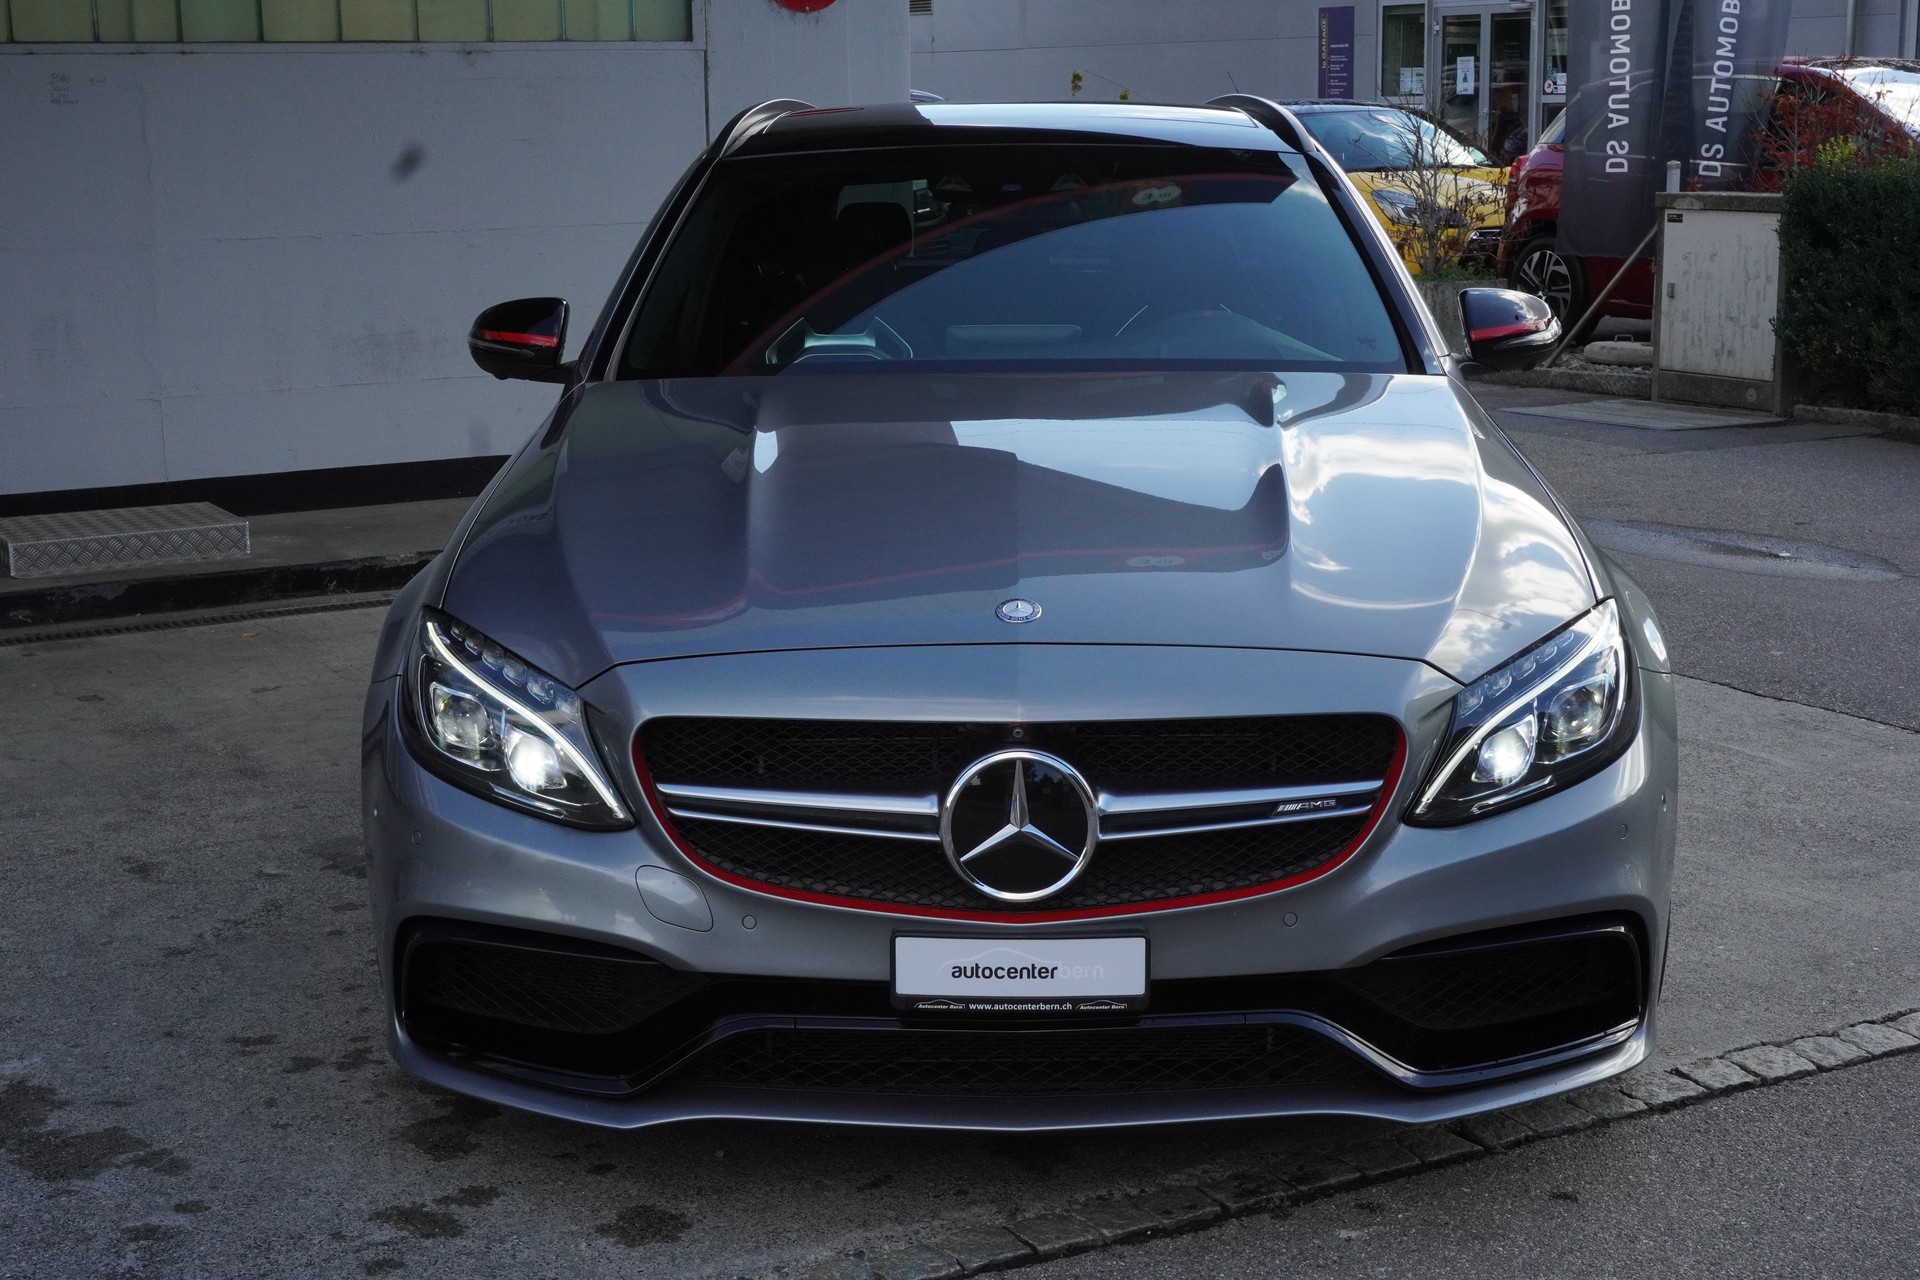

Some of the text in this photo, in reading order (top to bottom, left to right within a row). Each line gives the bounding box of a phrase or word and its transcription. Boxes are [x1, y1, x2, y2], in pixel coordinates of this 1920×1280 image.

[1698, 0, 1741, 177] DS AUTOMOB
[969, 1002, 1073, 1011] www.autocenterbern.ch
